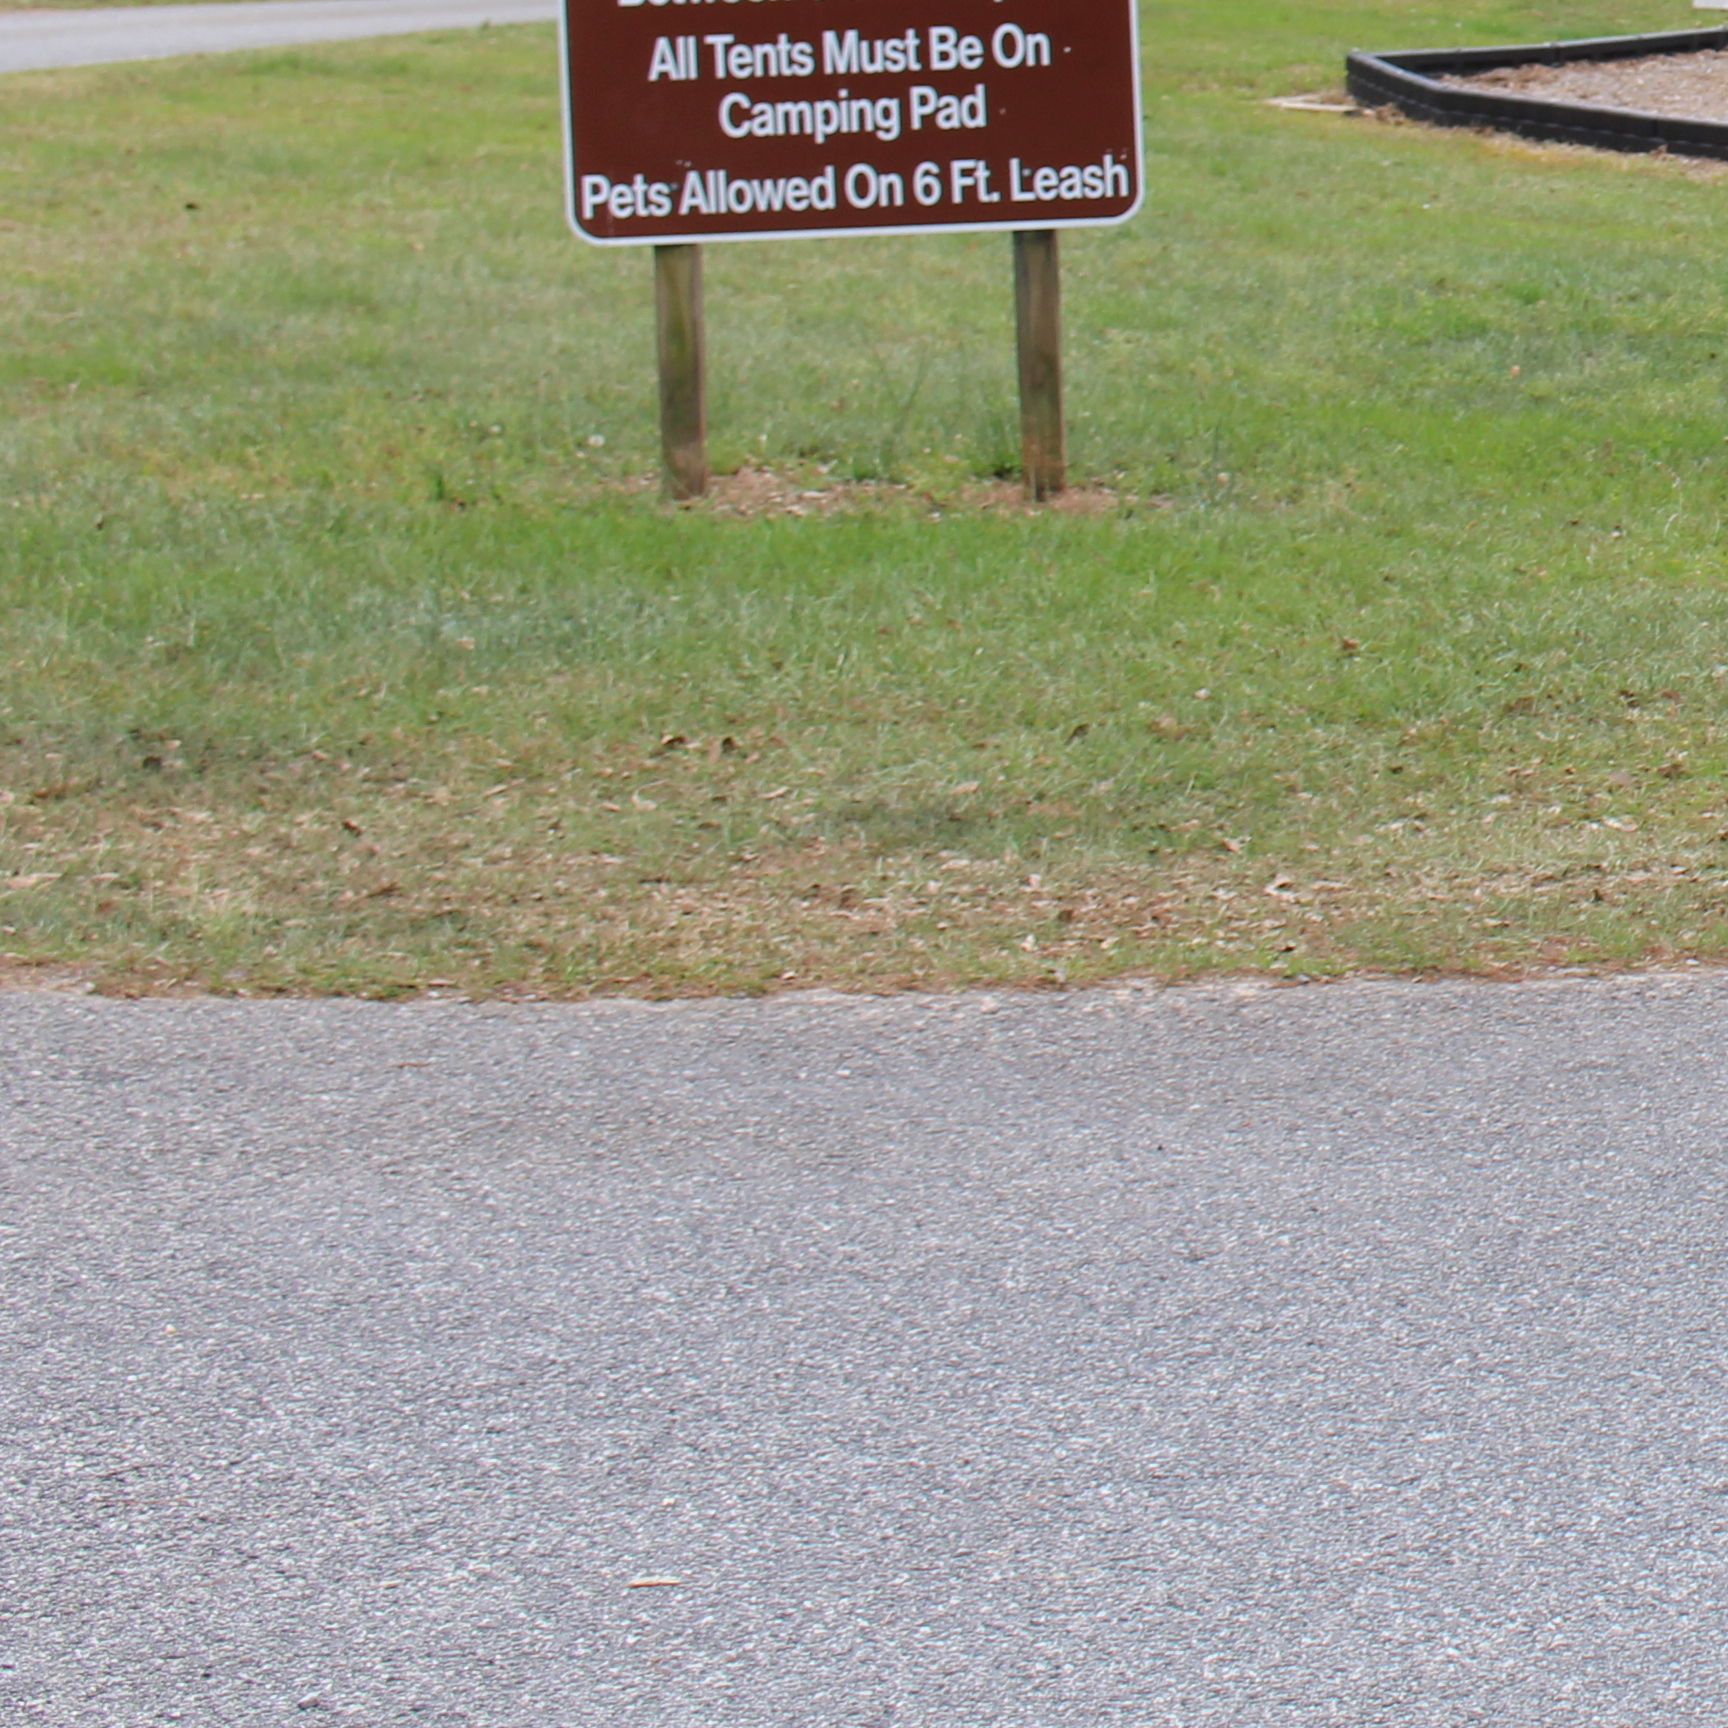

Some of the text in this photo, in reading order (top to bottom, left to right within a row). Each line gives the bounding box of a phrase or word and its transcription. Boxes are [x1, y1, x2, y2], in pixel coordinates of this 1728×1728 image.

[648, 23, 1051, 82] All Tents Must Be On
[719, 83, 986, 144] Camping Pad
[581, 153, 1129, 220] Pets Allowed On 6 Ft. Leash
